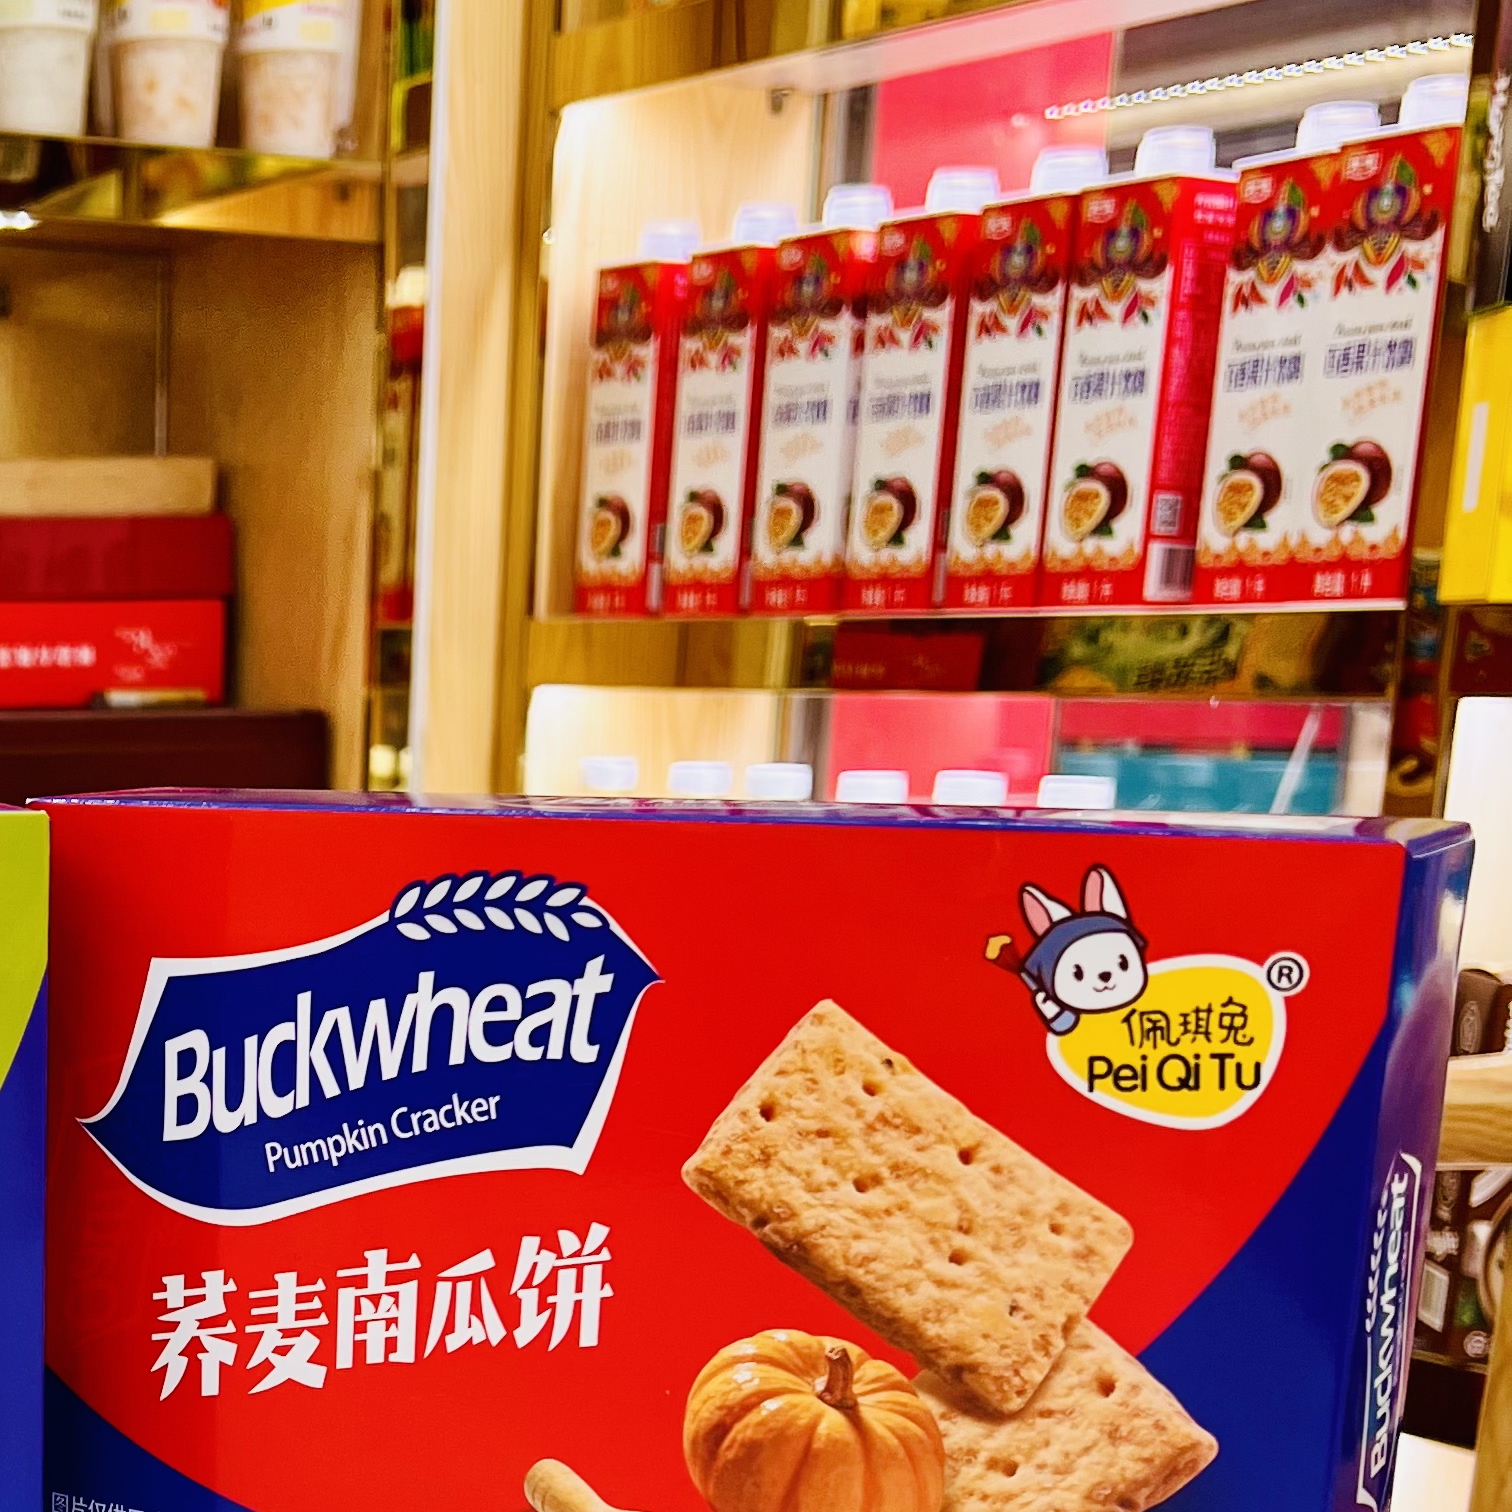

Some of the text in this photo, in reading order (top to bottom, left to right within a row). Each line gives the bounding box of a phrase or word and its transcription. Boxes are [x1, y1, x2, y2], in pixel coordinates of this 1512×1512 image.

[163, 954, 614, 1141] Buckwheat
[1121, 996, 1254, 1050] 佩琪兔
[264, 1092, 501, 1173] Pumpkin Cracker
[150, 1221, 614, 1401] 荞麦南瓜饼
